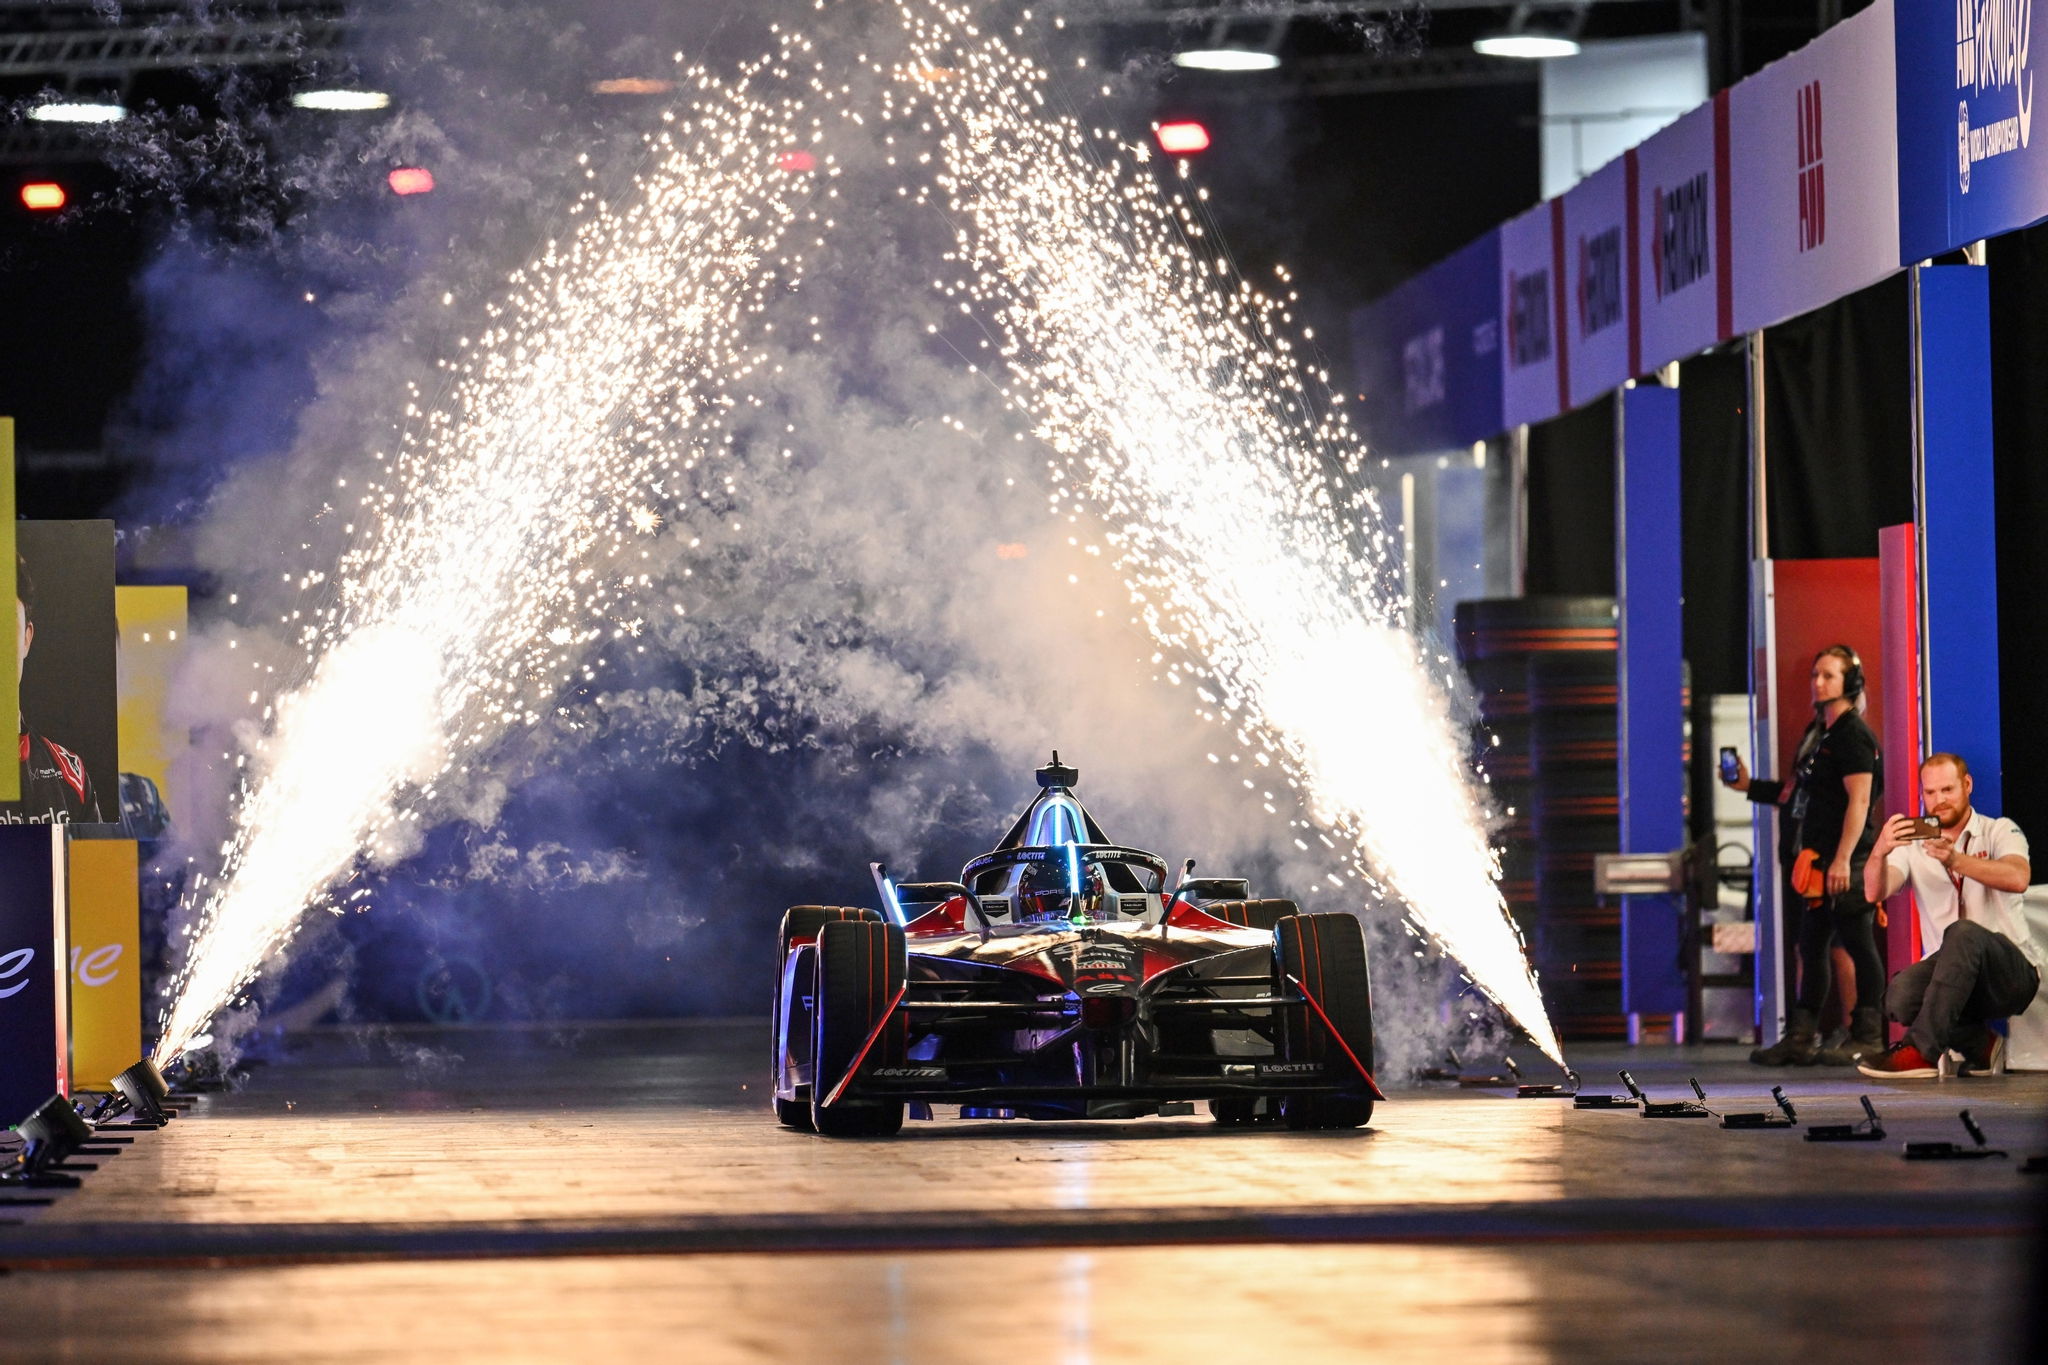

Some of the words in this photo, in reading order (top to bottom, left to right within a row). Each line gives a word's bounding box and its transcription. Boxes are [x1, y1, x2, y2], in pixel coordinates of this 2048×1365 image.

[1970, 126, 1986, 163] WORLD
[1017, 851, 1046, 860] LOCTITE
[872, 1068, 943, 1077] LOCTITE
